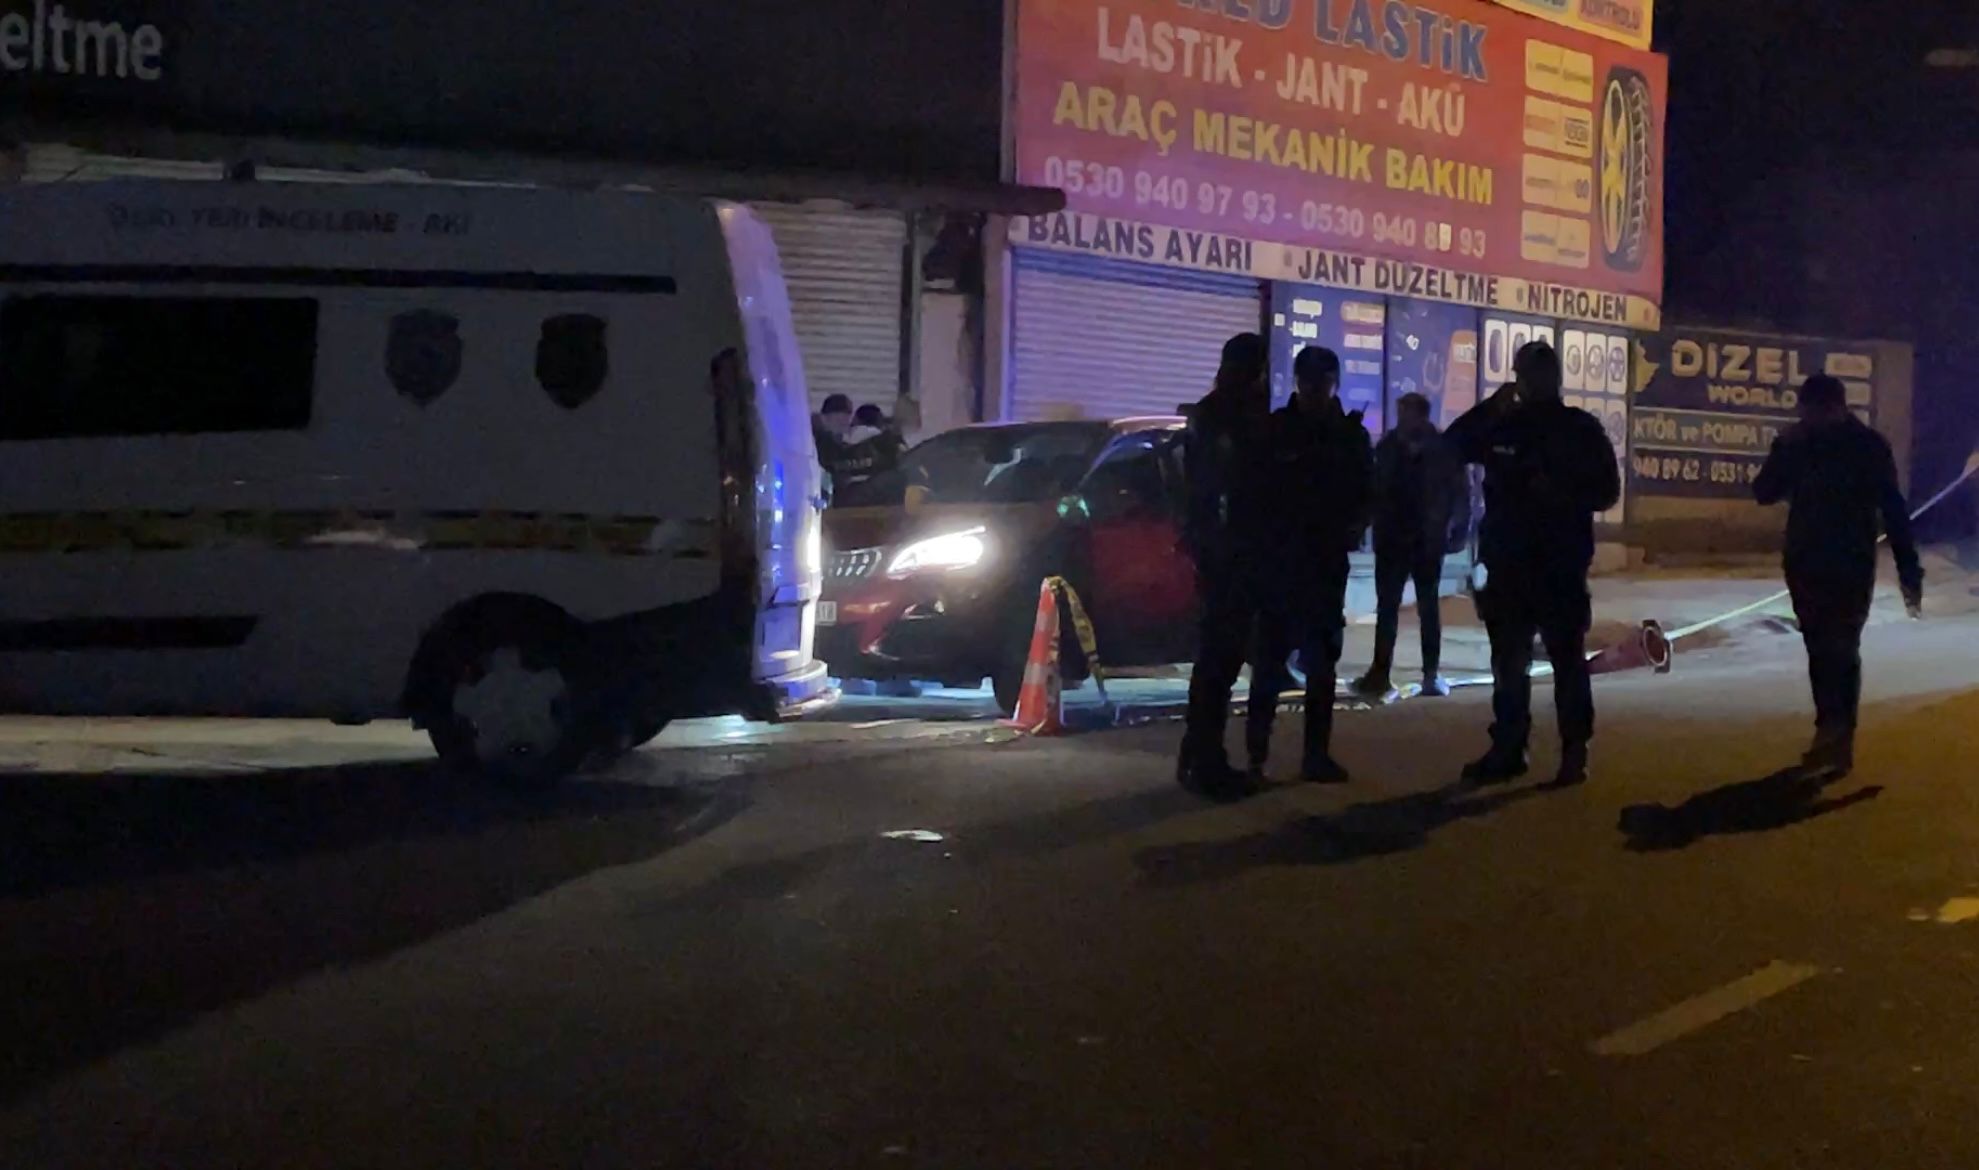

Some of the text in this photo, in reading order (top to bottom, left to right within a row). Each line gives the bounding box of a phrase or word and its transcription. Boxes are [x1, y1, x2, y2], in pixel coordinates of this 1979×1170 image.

[0, 0, 162, 80] eltme
[1276, 52, 1369, 115] JANT
[1397, 82, 1466, 137] AKÜ
[1053, 80, 1494, 205] ARAÇ MEKANİK BAKIM
[1044, 156, 1124, 198] 0530
[1134, 171, 1188, 210] 940
[1198, 182, 1233, 216] 97
[1242, 190, 1276, 224] 93
[1302, 200, 1365, 239] 0530
[1373, 212, 1417, 247] 940
[1459, 226, 1487, 259] 93
[1028, 213, 1252, 271] BALANS AYARI
[1298, 250, 1365, 286] JANT
[1528, 282, 1627, 321] NITROJEN
[1707, 384, 1798, 409] WORLD
[1680, 425, 1699, 442] ve
[1702, 422, 1758, 446] POMPA
[1683, 458, 1701, 481] 62
